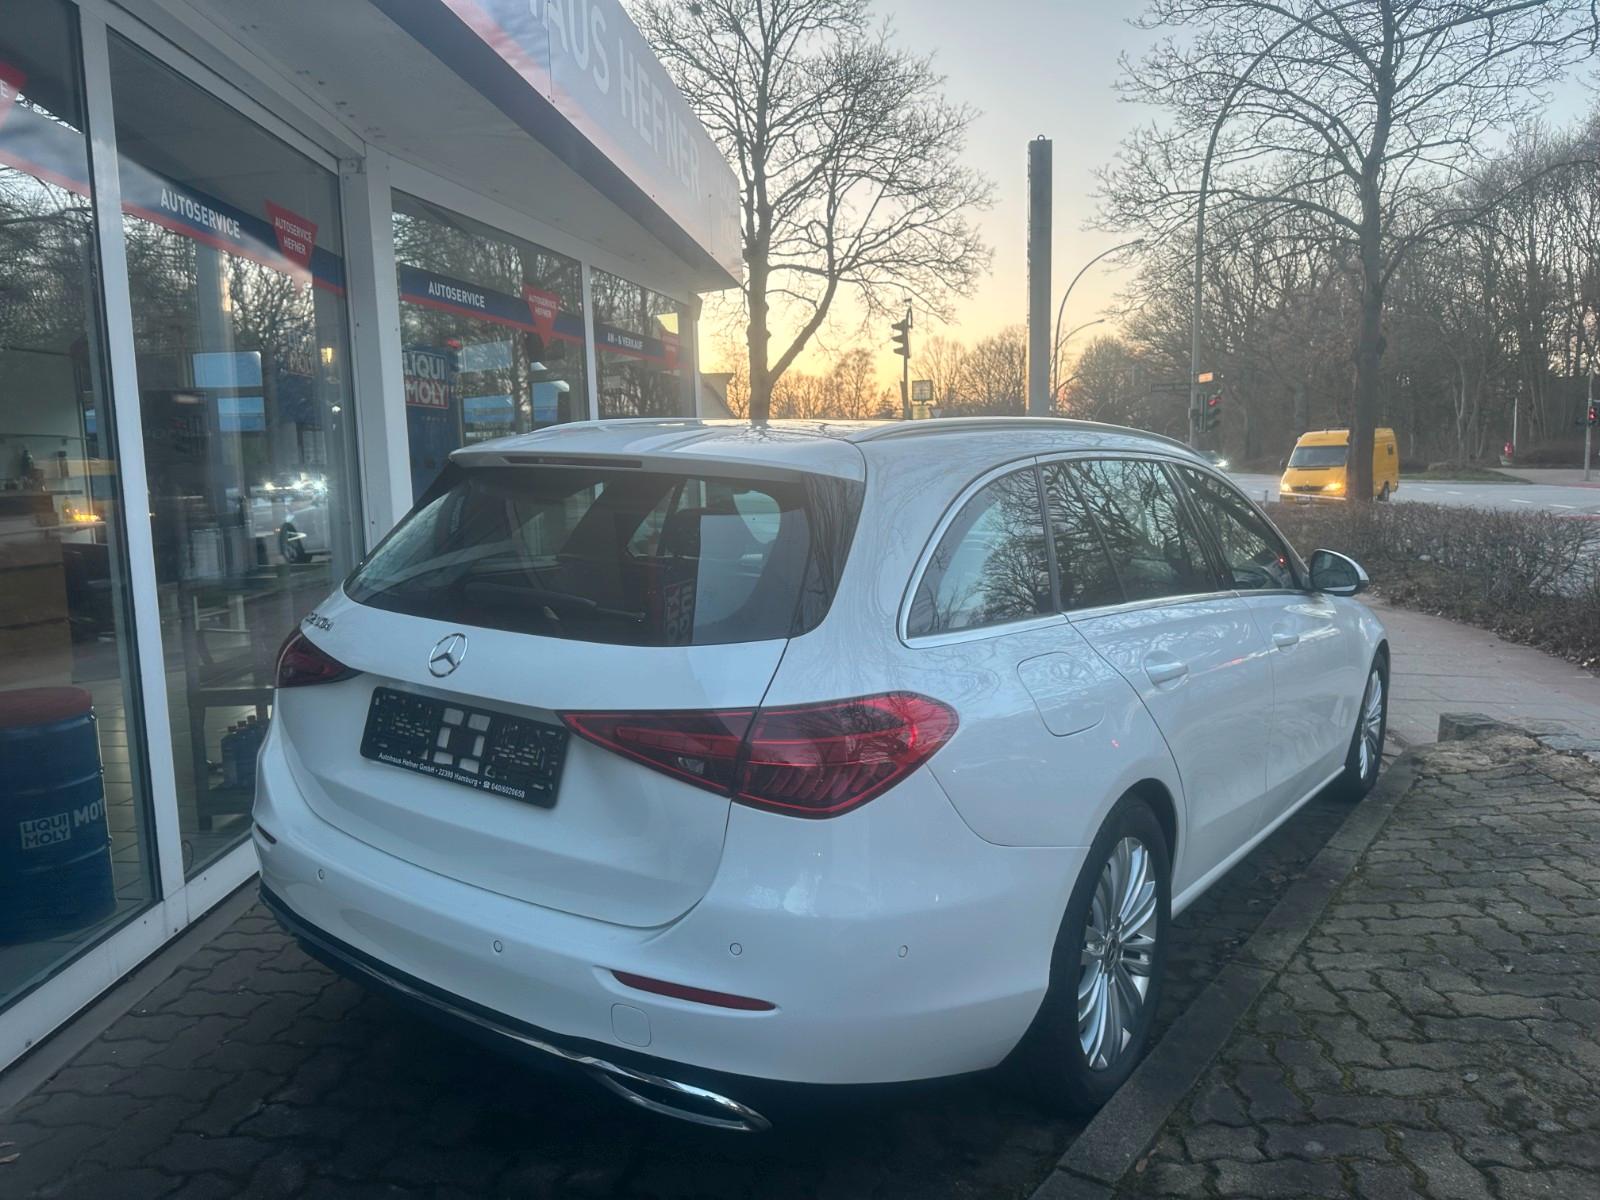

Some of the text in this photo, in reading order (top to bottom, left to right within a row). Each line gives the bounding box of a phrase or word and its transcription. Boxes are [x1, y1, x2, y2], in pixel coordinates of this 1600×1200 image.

[618, 37, 701, 201] HEFNER
[160, 188, 241, 239] AUTOSERVICE
[275, 216, 313, 244] AUTOSERVICE
[283, 236, 306, 255] HEFNER
[428, 280, 486, 308] AUTOSERVICE
[403, 351, 446, 379] LIQUI
[405, 379, 447, 405] MOLY
[378, 752, 401, 765] Autohaus
[419, 763, 435, 774] GmbH
[454, 773, 479, 788] Hamburg
[23, 815, 67, 833] LIQUI
[25, 828, 67, 848] MOLY
